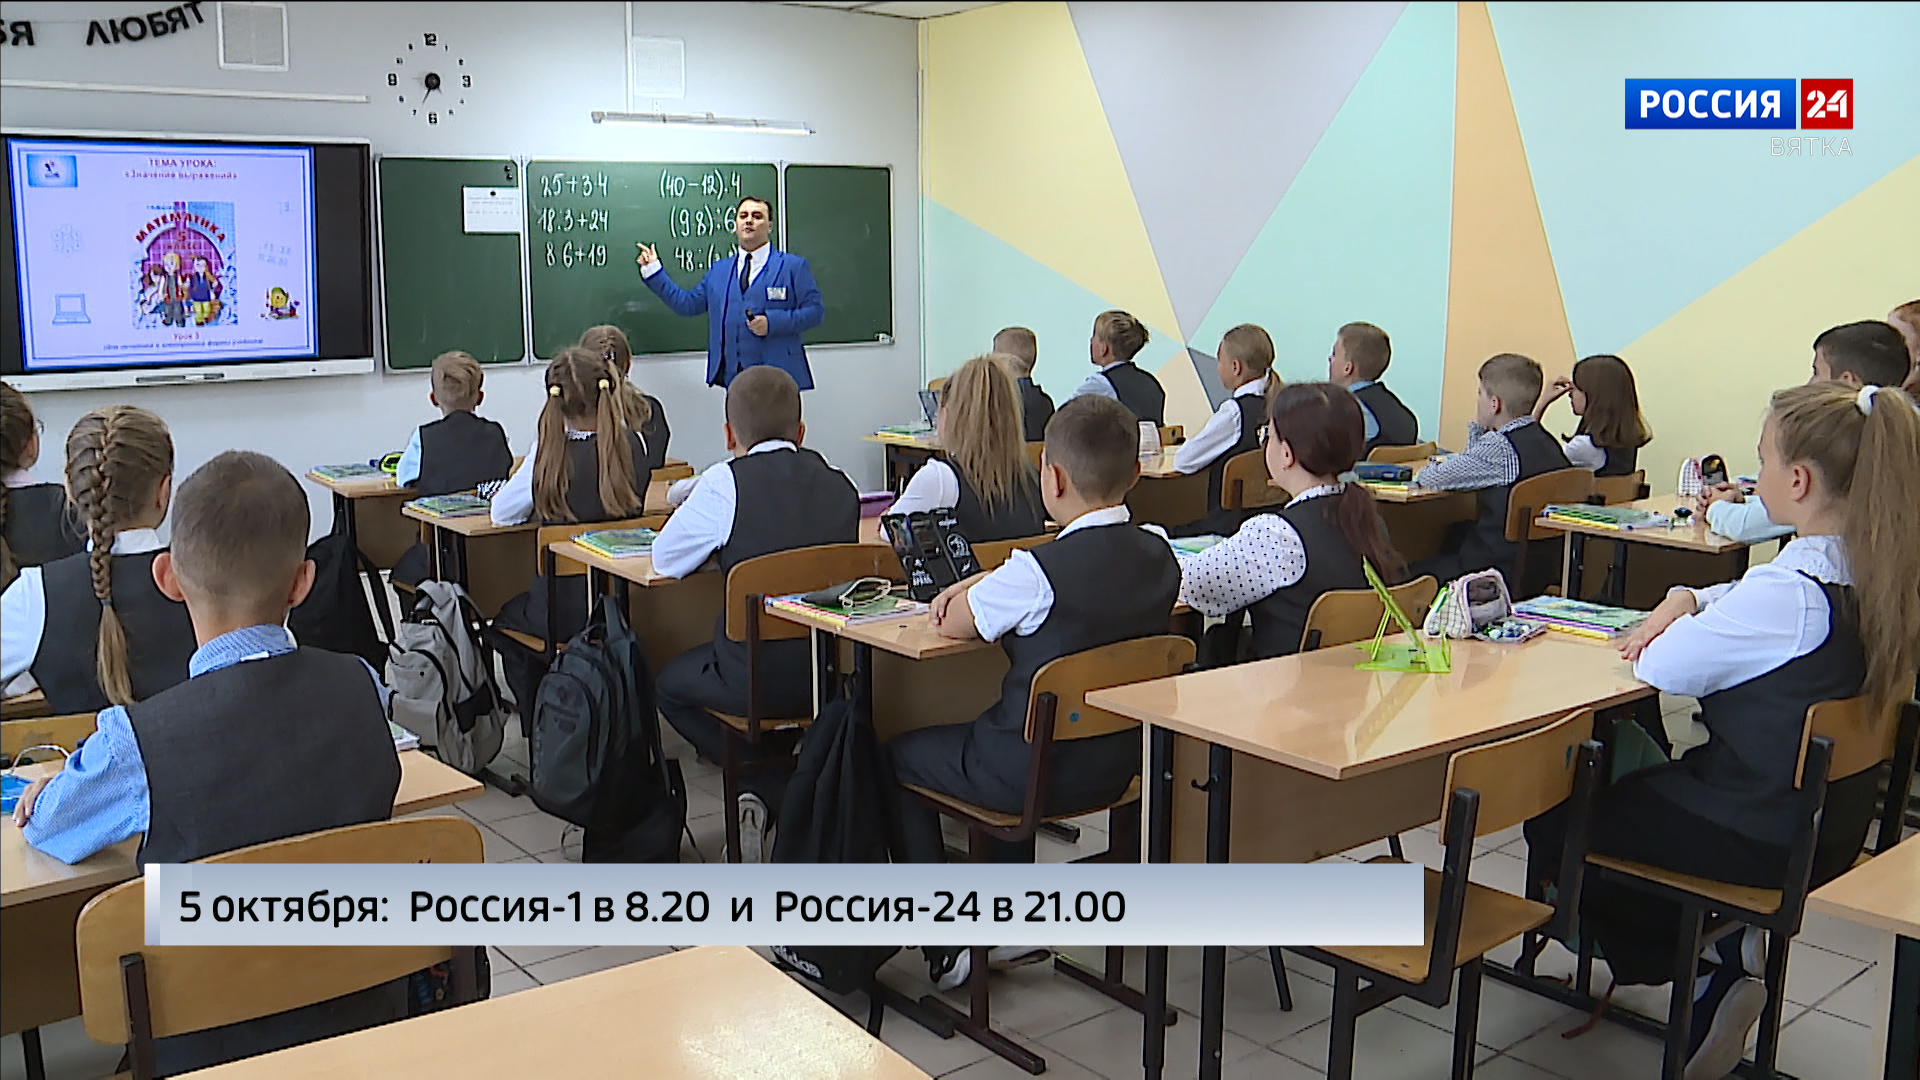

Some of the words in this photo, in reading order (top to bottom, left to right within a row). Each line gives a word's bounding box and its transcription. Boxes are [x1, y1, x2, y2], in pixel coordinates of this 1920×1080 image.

[86, 2, 204, 46] ЛЮБЯТ
[424, 33, 437, 46] 12
[462, 75, 471, 87] 3
[136, 212, 225, 243] МАТЕМАТИКА
